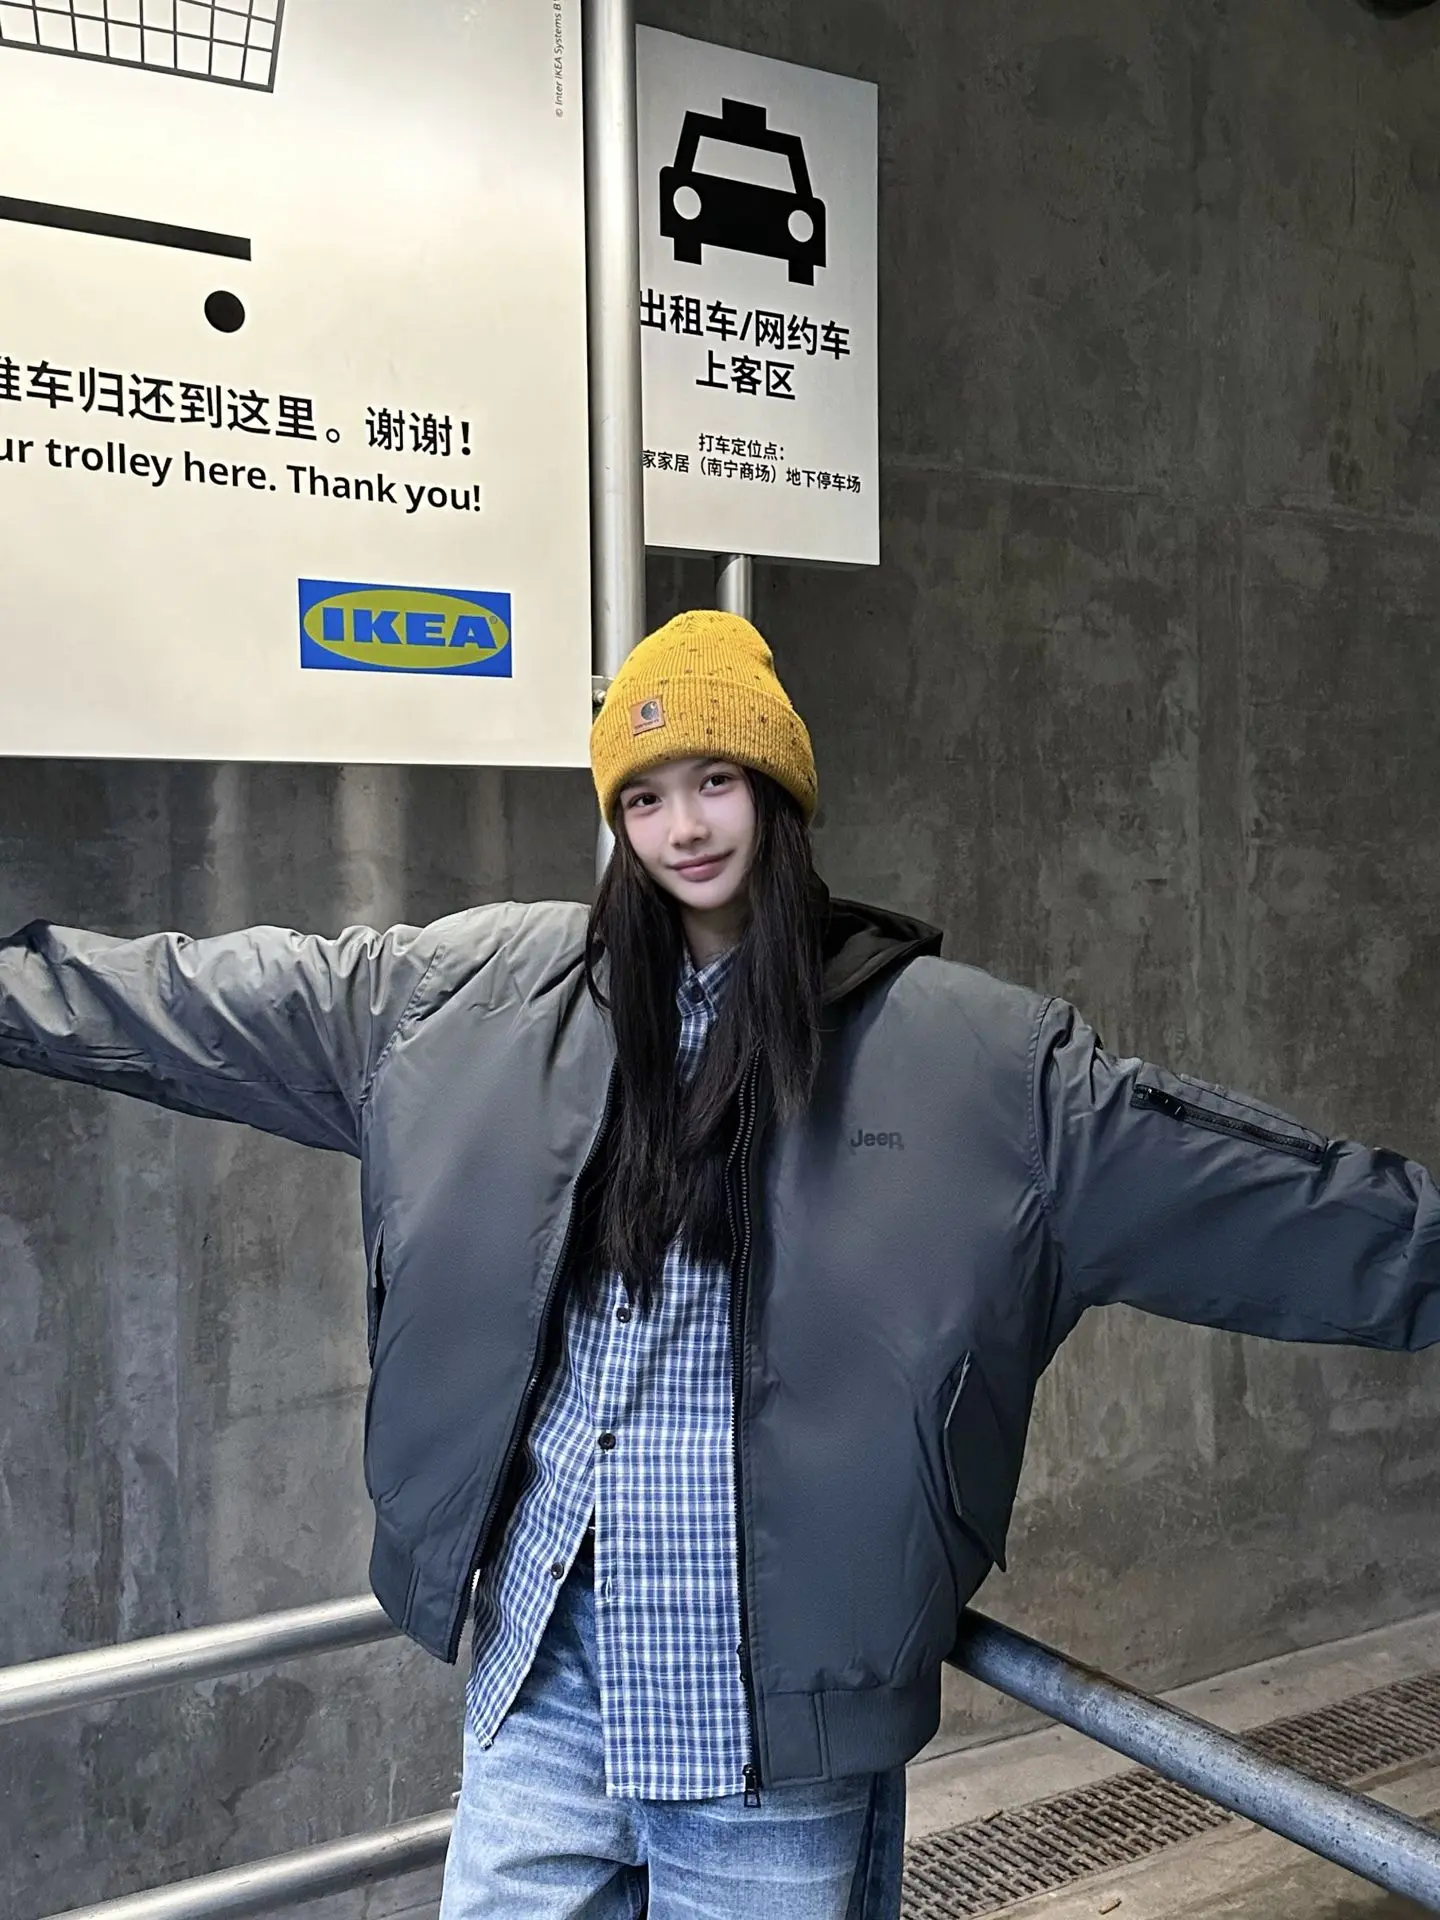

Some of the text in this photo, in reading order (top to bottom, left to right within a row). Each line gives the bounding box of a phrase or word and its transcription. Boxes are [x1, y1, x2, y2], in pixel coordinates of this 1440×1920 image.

[554, 13, 564, 54] Systems
[554, 57, 562, 79] IKEA
[640, 288, 850, 360] 出租车/网约车
[696, 350, 796, 400] 上客区
[698, 433, 785, 461] 打车定位点：
[45, 439, 172, 487] trolley
[185, 451, 276, 492] here.
[287, 465, 398, 503] Thank
[405, 484, 480, 514] you!
[322, 607, 497, 649] IKEA
[850, 1129, 905, 1151] Jeep
